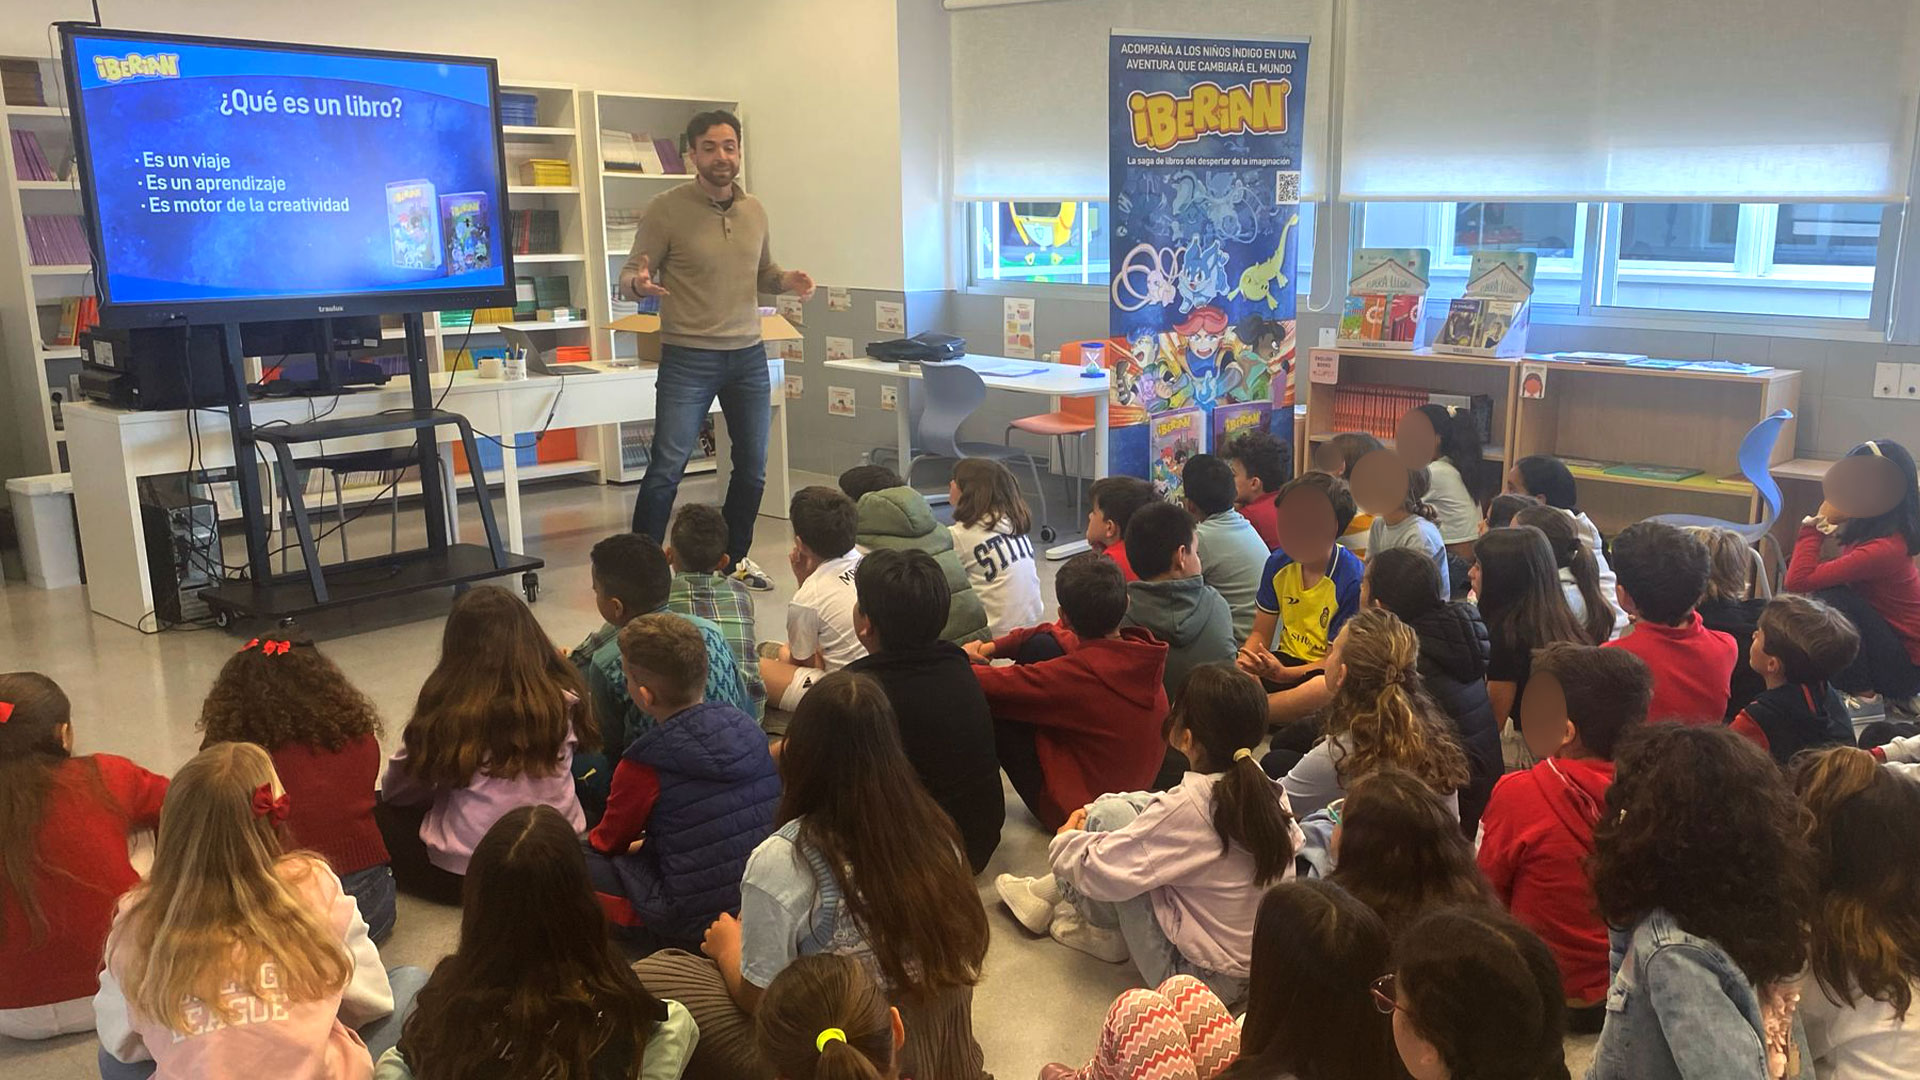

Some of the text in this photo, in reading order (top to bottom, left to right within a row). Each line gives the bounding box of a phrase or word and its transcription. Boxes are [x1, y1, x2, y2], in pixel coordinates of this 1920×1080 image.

[1121, 41, 1174, 55] ACOMPAÑA
[1175, 44, 1183, 55] A
[1183, 45, 1201, 56] LOS
[1203, 44, 1231, 57] NIÑOS
[1264, 48, 1277, 59] EN
[1278, 49, 1297, 60] UNA
[1126, 58, 1292, 74] AVENTURA QUE CAMBIARÁ EL MUNDO
[220, 88, 402, 118] ¿Qué es un libro?
[143, 151, 231, 172] Es un viaje
[1127, 156, 1291, 167] La saga de libros del despertar de la imaginación
[146, 174, 287, 194] Es un aprendizaje
[149, 196, 350, 213] Es motor de la creatividad
